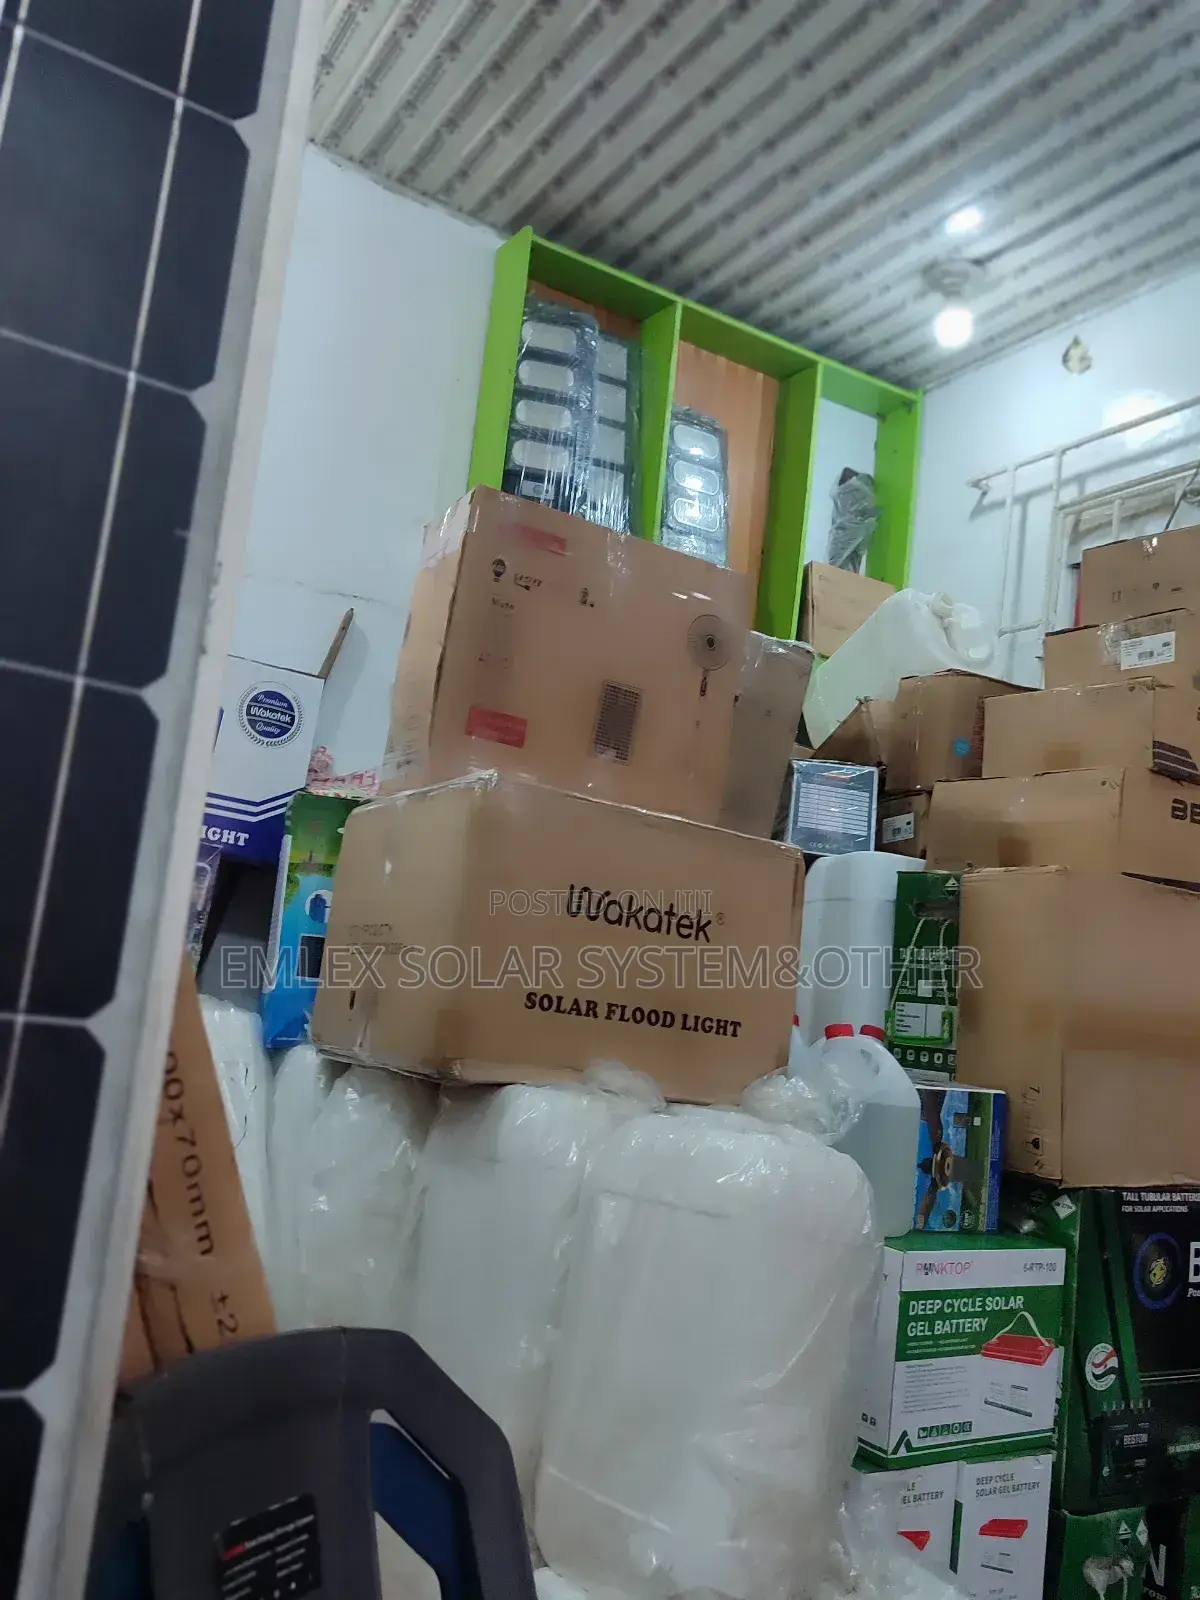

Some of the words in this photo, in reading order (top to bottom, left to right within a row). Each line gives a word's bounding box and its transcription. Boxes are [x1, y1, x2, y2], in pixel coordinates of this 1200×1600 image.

[257, 694, 288, 708] Premium
[256, 721, 281, 735] Quality
[566, 884, 712, 943] Wakatek
[524, 991, 599, 1019] SOLAR
[604, 1003, 676, 1029] FLOOD
[681, 1014, 742, 1038] LIGHT
[1122, 1192, 1140, 1202] TALL
[1140, 1192, 1172, 1202] TUBULAR
[1121, 1205, 1134, 1213] FOR
[1134, 1205, 1151, 1213] SOLAR
[1152, 1205, 1189, 1213] APPLICATIONS
[909, 1300, 942, 1316] DEEP
[943, 1298, 983, 1313] CYCLE
[985, 1295, 1024, 1311] SOLAR
[907, 1321, 934, 1337] GEL
[934, 1317, 988, 1335] BATTERY
[976, 1475, 993, 1486] DEEP
[995, 1473, 1015, 1484] CYCLE
[913, 1490, 944, 1503] BATTERY
[975, 1485, 998, 1498] SOLAR
[998, 1484, 1011, 1495] GEL
[1012, 1481, 1040, 1493] BATTERY
